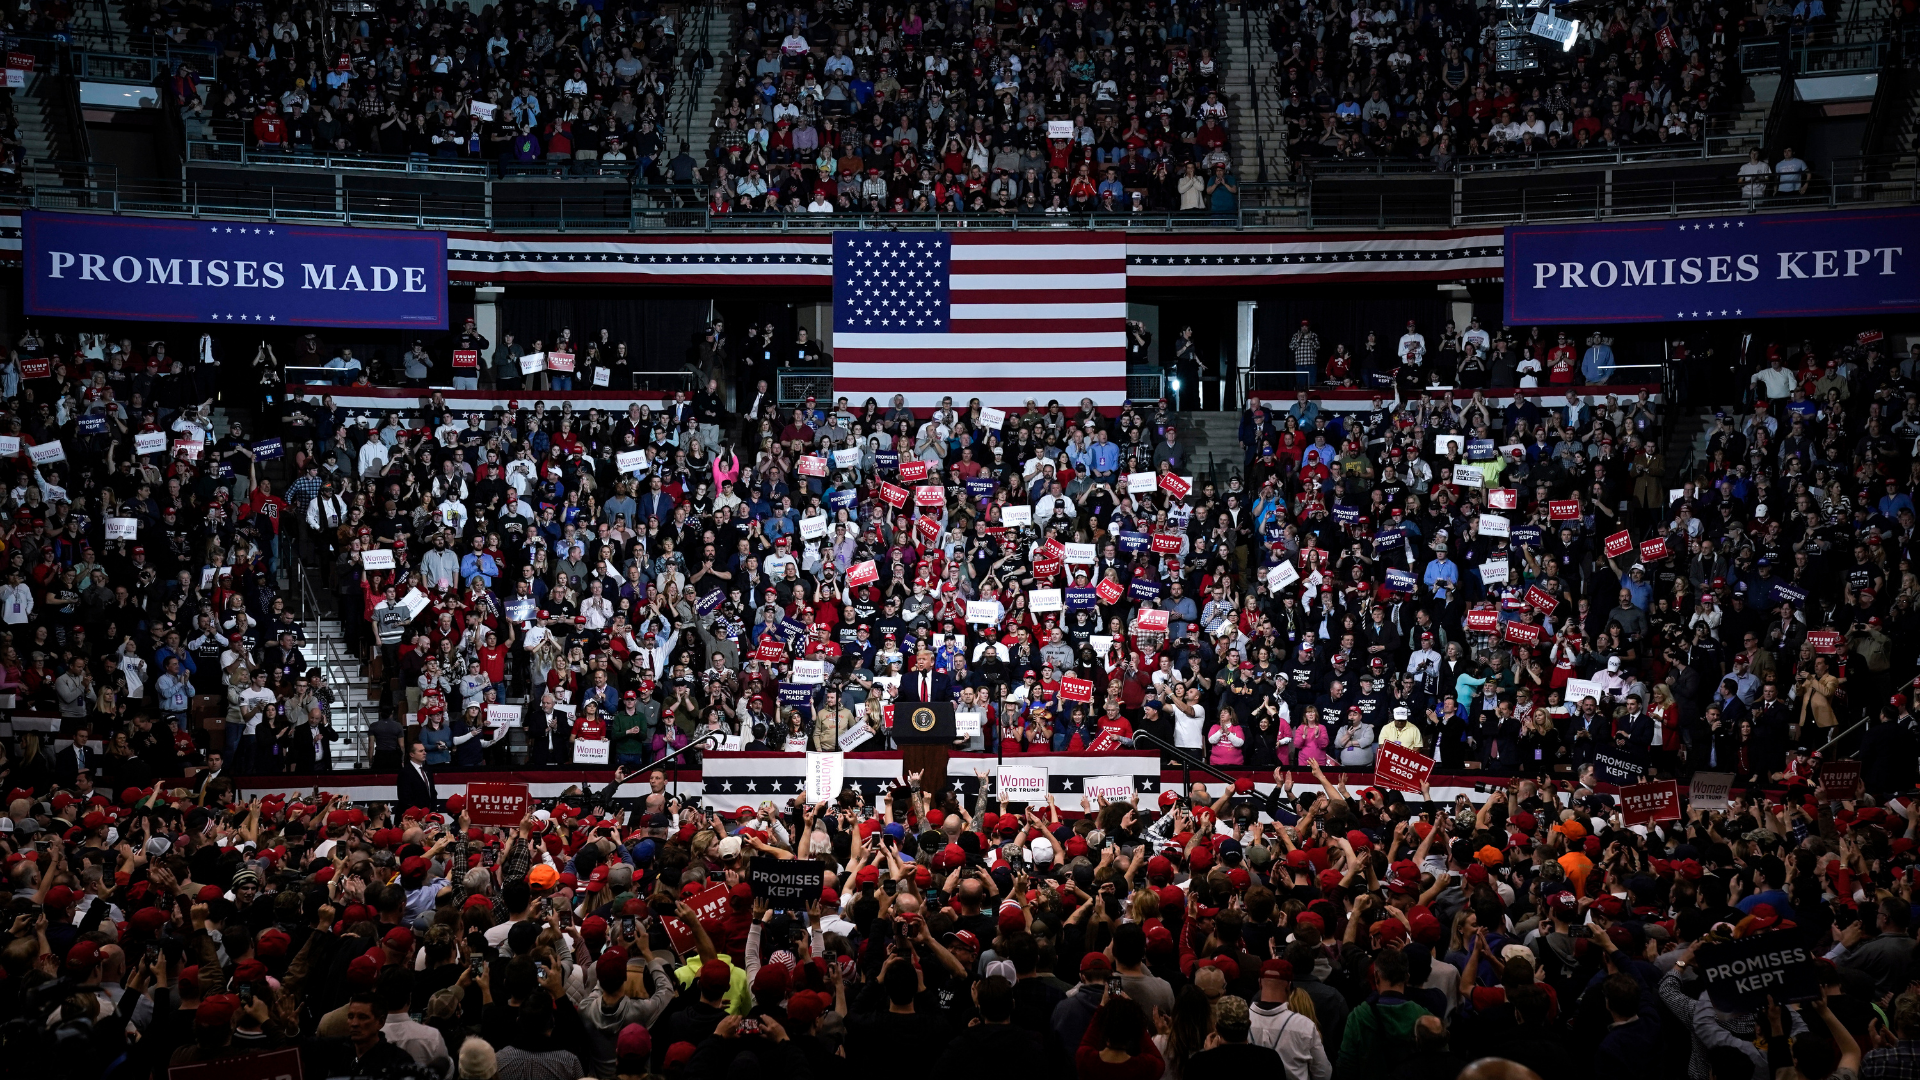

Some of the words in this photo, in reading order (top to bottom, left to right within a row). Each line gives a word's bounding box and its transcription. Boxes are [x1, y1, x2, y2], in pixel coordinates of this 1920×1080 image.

[48, 251, 285, 288] PROMISES
[301, 263, 427, 293] MADE
[1532, 254, 1759, 289] PROMISES
[1776, 247, 1902, 281] KEPT
[982, 413, 1002, 422] Women
[139, 438, 163, 446] Women
[33, 447, 61, 458] Women
[253, 443, 281, 452] PROMISES
[620, 456, 644, 465] Women
[835, 453, 858, 461] Women
[1130, 478, 1153, 486] Women
[883, 487, 905, 498] TRUMP
[830, 494, 856, 502] PROMISES
[261, 503, 277, 518] 45
[108, 523, 134, 531] Women
[803, 522, 825, 530] Women
[920, 519, 937, 534] TRUMP
[1607, 537, 1627, 547] TRUMP
[1048, 543, 1064, 553] TRUM
[1642, 543, 1663, 552] TRUMP
[849, 567, 875, 576] TRUMP
[1269, 567, 1293, 585] Women
[1387, 575, 1415, 583] PROMISES
[1102, 583, 1120, 595] TRUMP
[1132, 584, 1159, 593] PROMISES
[1774, 585, 1805, 600] PROMISES
[1531, 591, 1553, 606] TRUMP
[1779, 592, 1795, 601] KEPT
[703, 597, 717, 608] MADE
[969, 607, 996, 615] Women
[781, 621, 803, 633] PROMISES
[1509, 628, 1535, 636] TRUMP
[795, 666, 821, 674] Women
[1063, 682, 1090, 690] TRUMP
[1569, 685, 1598, 695] Women
[490, 710, 518, 718] Women
[577, 745, 606, 754] Women
[1384, 750, 1429, 773] TRUMP
[1596, 754, 1643, 774] PROMISES
[1390, 767, 1413, 780] 2020
[1606, 766, 1628, 779] KEPT
[1823, 772, 1856, 780] TRUMP
[821, 756, 834, 802] Women
[1000, 775, 1044, 787] Women
[1694, 782, 1727, 794] Women
[471, 795, 523, 804] TRUMP
[1625, 791, 1673, 805] TRUMP
[1630, 800, 1669, 810] PENCE
[752, 871, 820, 885] PROMISES
[768, 886, 803, 897] KEPT
[669, 896, 727, 927] TUMP
[1706, 948, 1806, 982] PROMISES
[1735, 970, 1785, 993] KEPT
